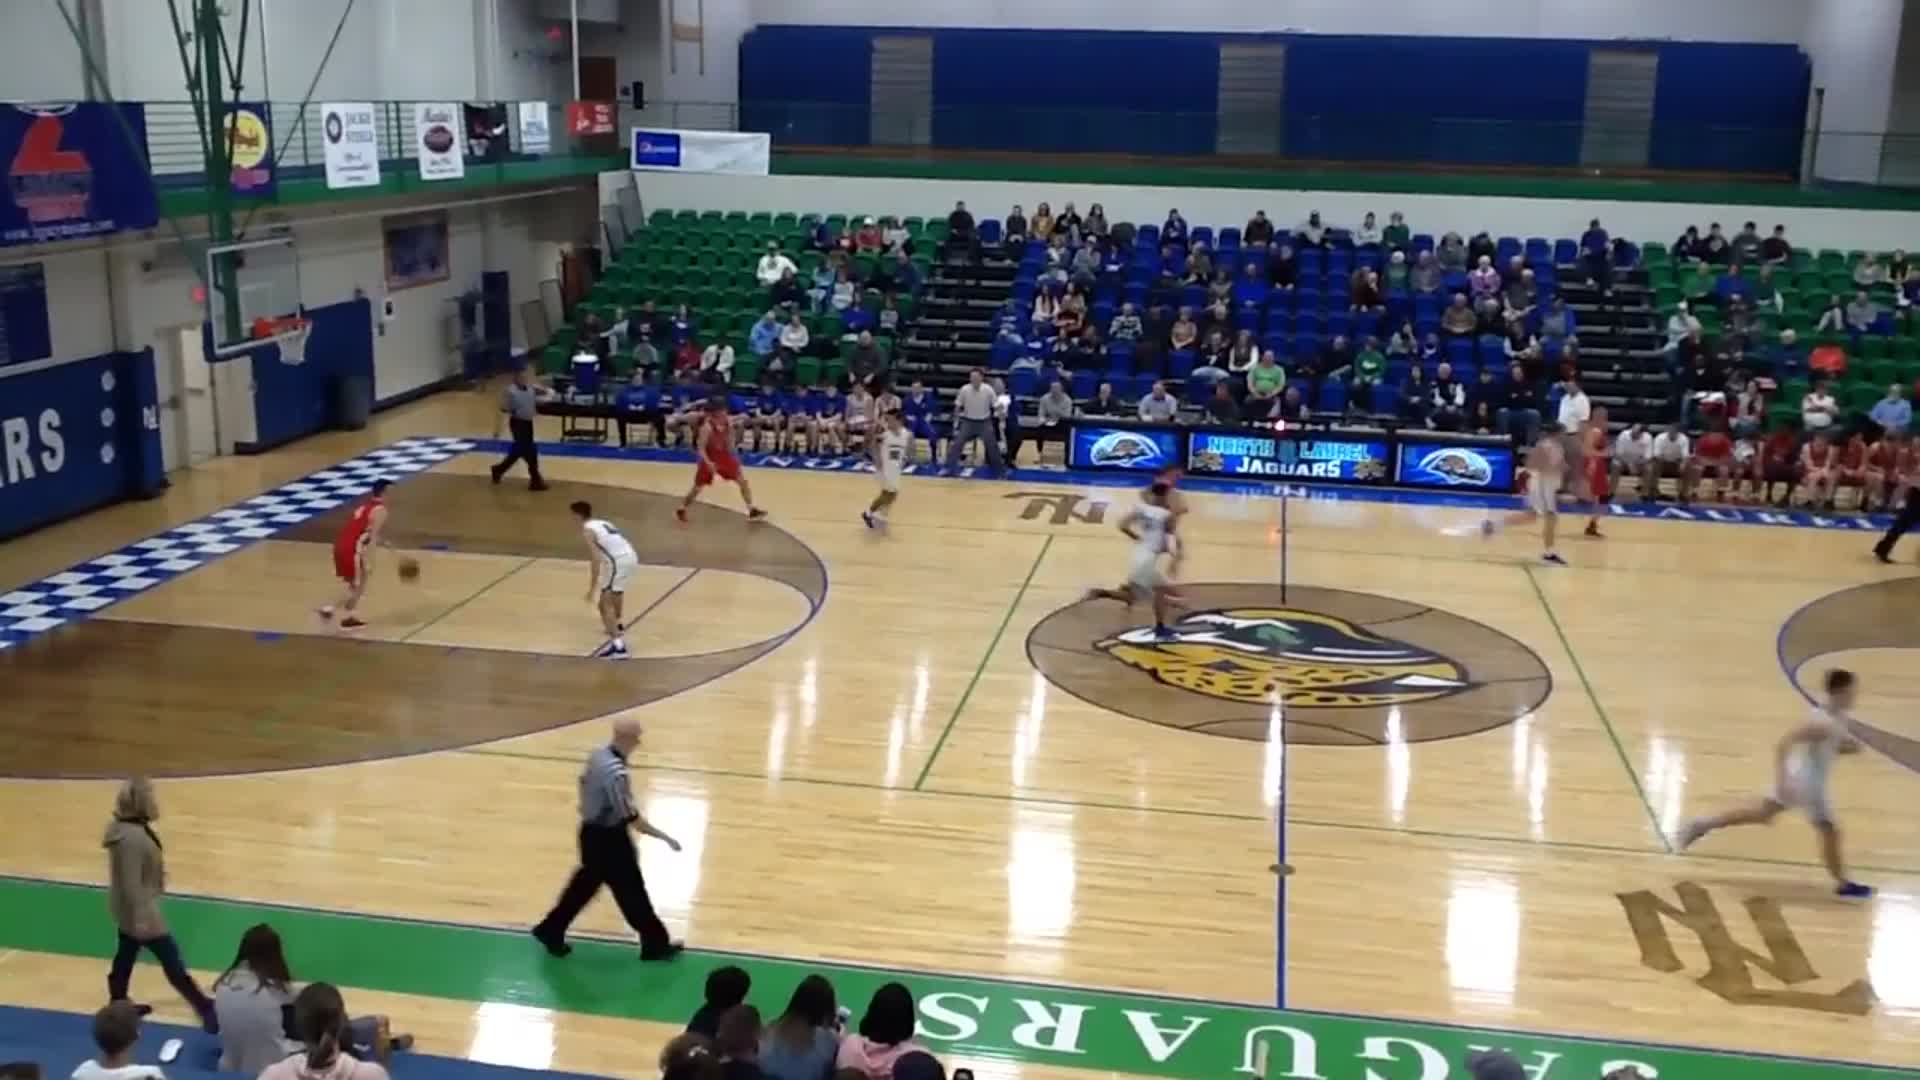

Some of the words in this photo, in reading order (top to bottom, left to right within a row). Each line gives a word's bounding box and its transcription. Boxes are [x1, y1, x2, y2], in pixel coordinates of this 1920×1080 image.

[1207, 436, 1275, 458] NORTH
[1299, 440, 1371, 463] LAUREL
[1235, 457, 1342, 479] JAGUARS
